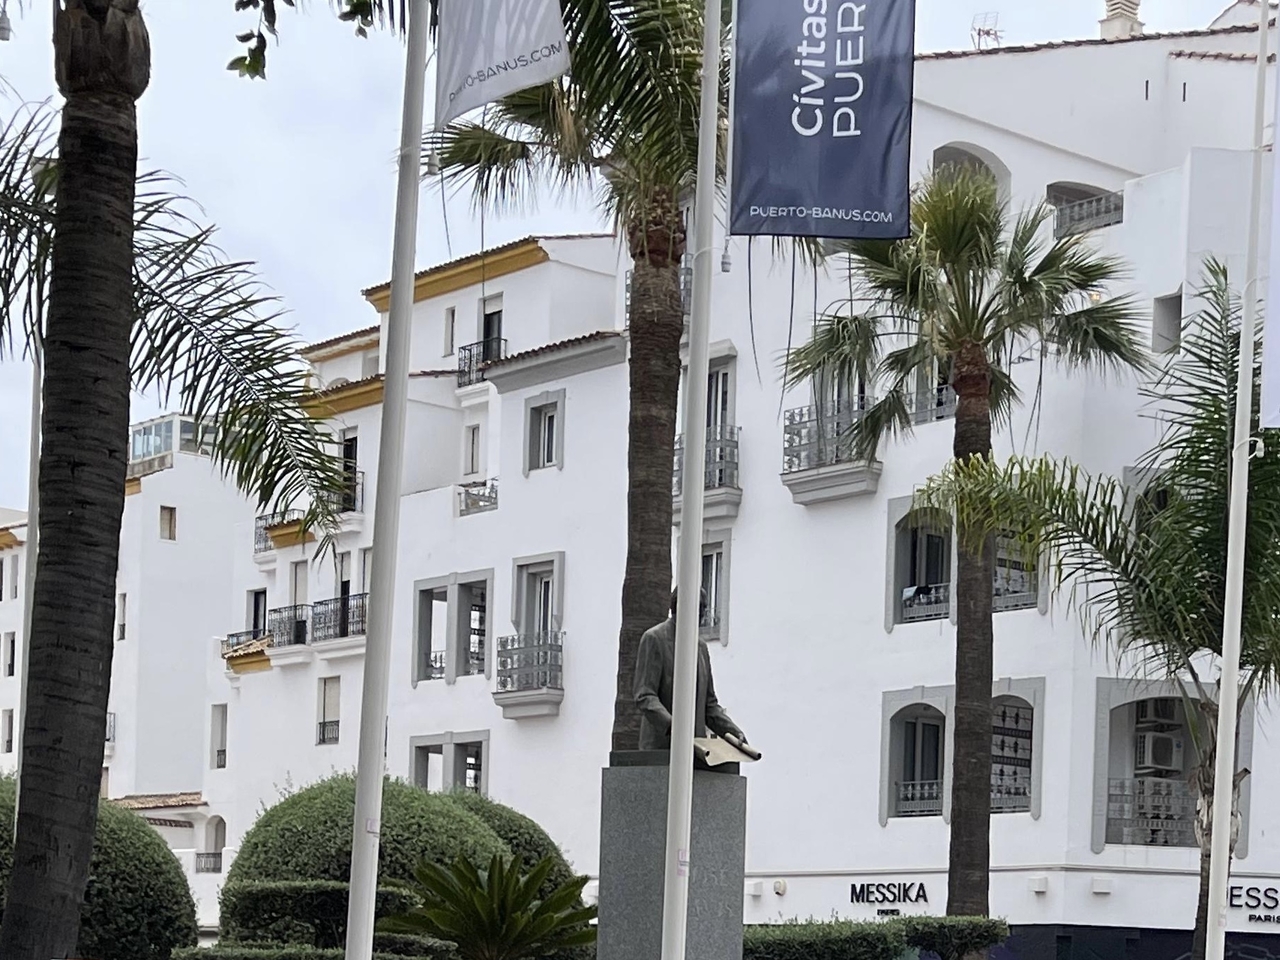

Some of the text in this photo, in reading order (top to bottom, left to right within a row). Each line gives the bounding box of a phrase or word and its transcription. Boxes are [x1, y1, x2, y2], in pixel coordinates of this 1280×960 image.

[791, 0, 828, 137] Cívitas
[749, 205, 893, 223] PUERTO-BANUS.COM
[850, 882, 929, 903] MESSIKA
